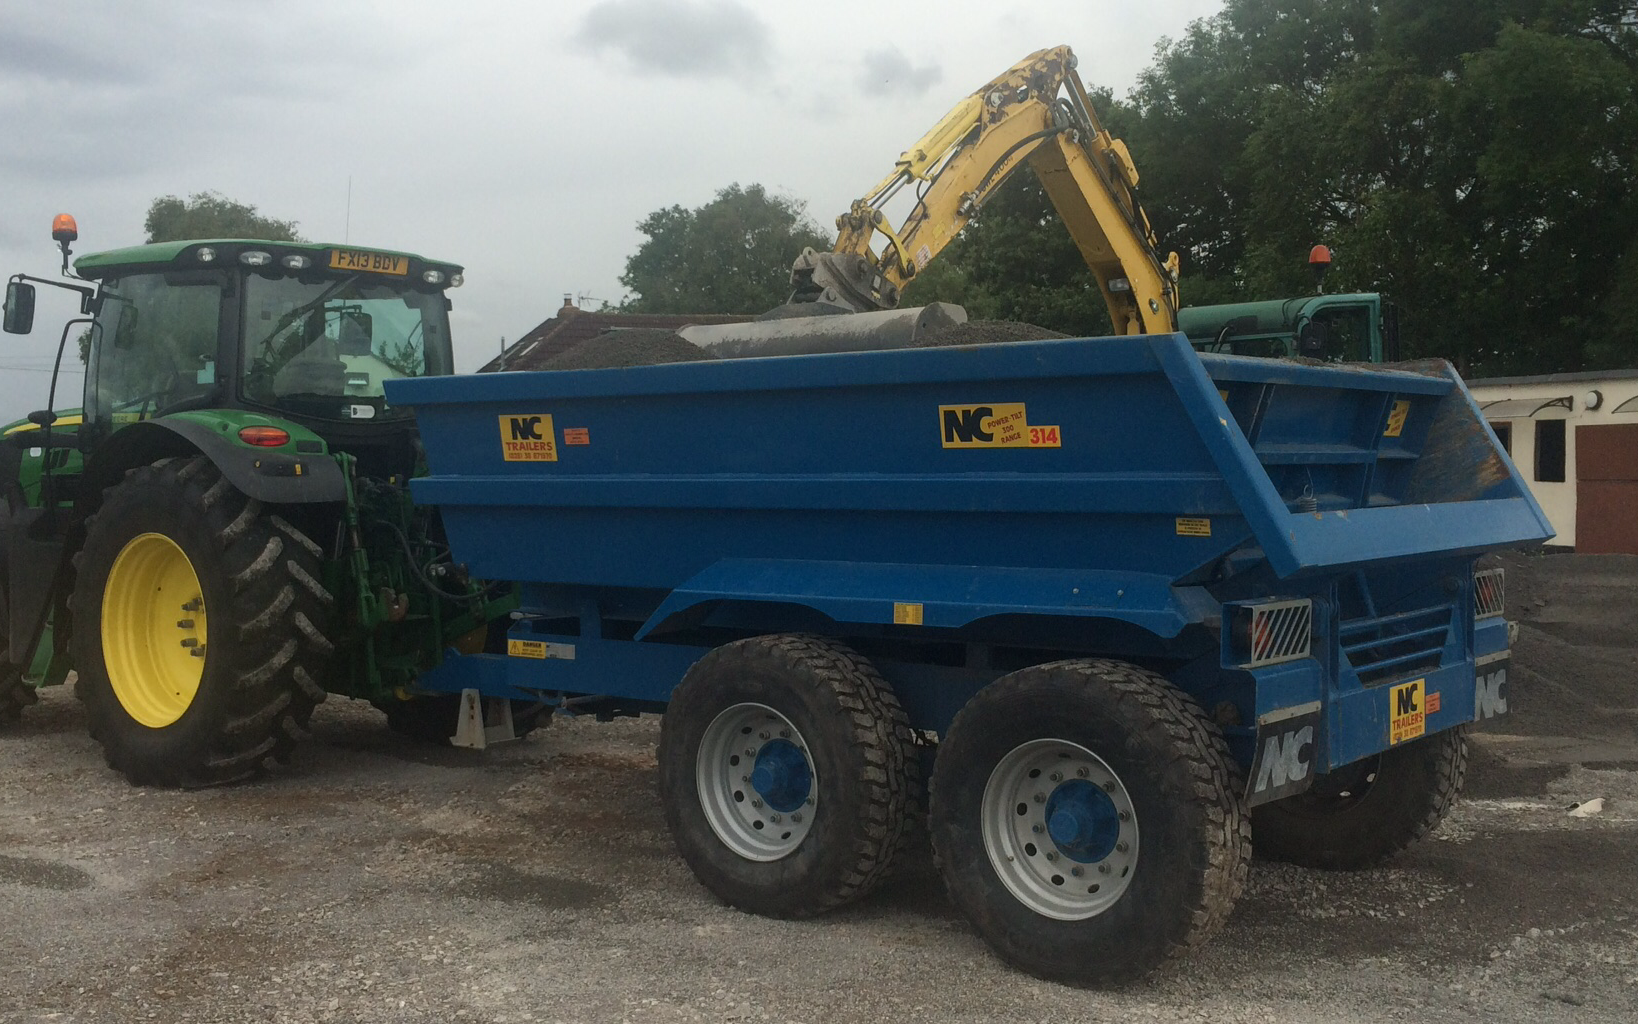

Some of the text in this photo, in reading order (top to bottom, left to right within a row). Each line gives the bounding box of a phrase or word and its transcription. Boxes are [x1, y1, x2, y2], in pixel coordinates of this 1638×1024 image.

[338, 251, 369, 267] FX13
[510, 416, 542, 440] NC
[943, 407, 993, 442] NC
[987, 411, 1023, 429] POWER-TILT
[1002, 425, 1014, 433] 300
[1001, 432, 1021, 444] RANGE
[1030, 428, 1058, 444] 314
[506, 442, 552, 451] TRAILERS
[1397, 683, 1418, 716] NC
[1475, 669, 1507, 721] NC
[1392, 712, 1423, 731] TRAILERS
[1255, 726, 1313, 793] NC
